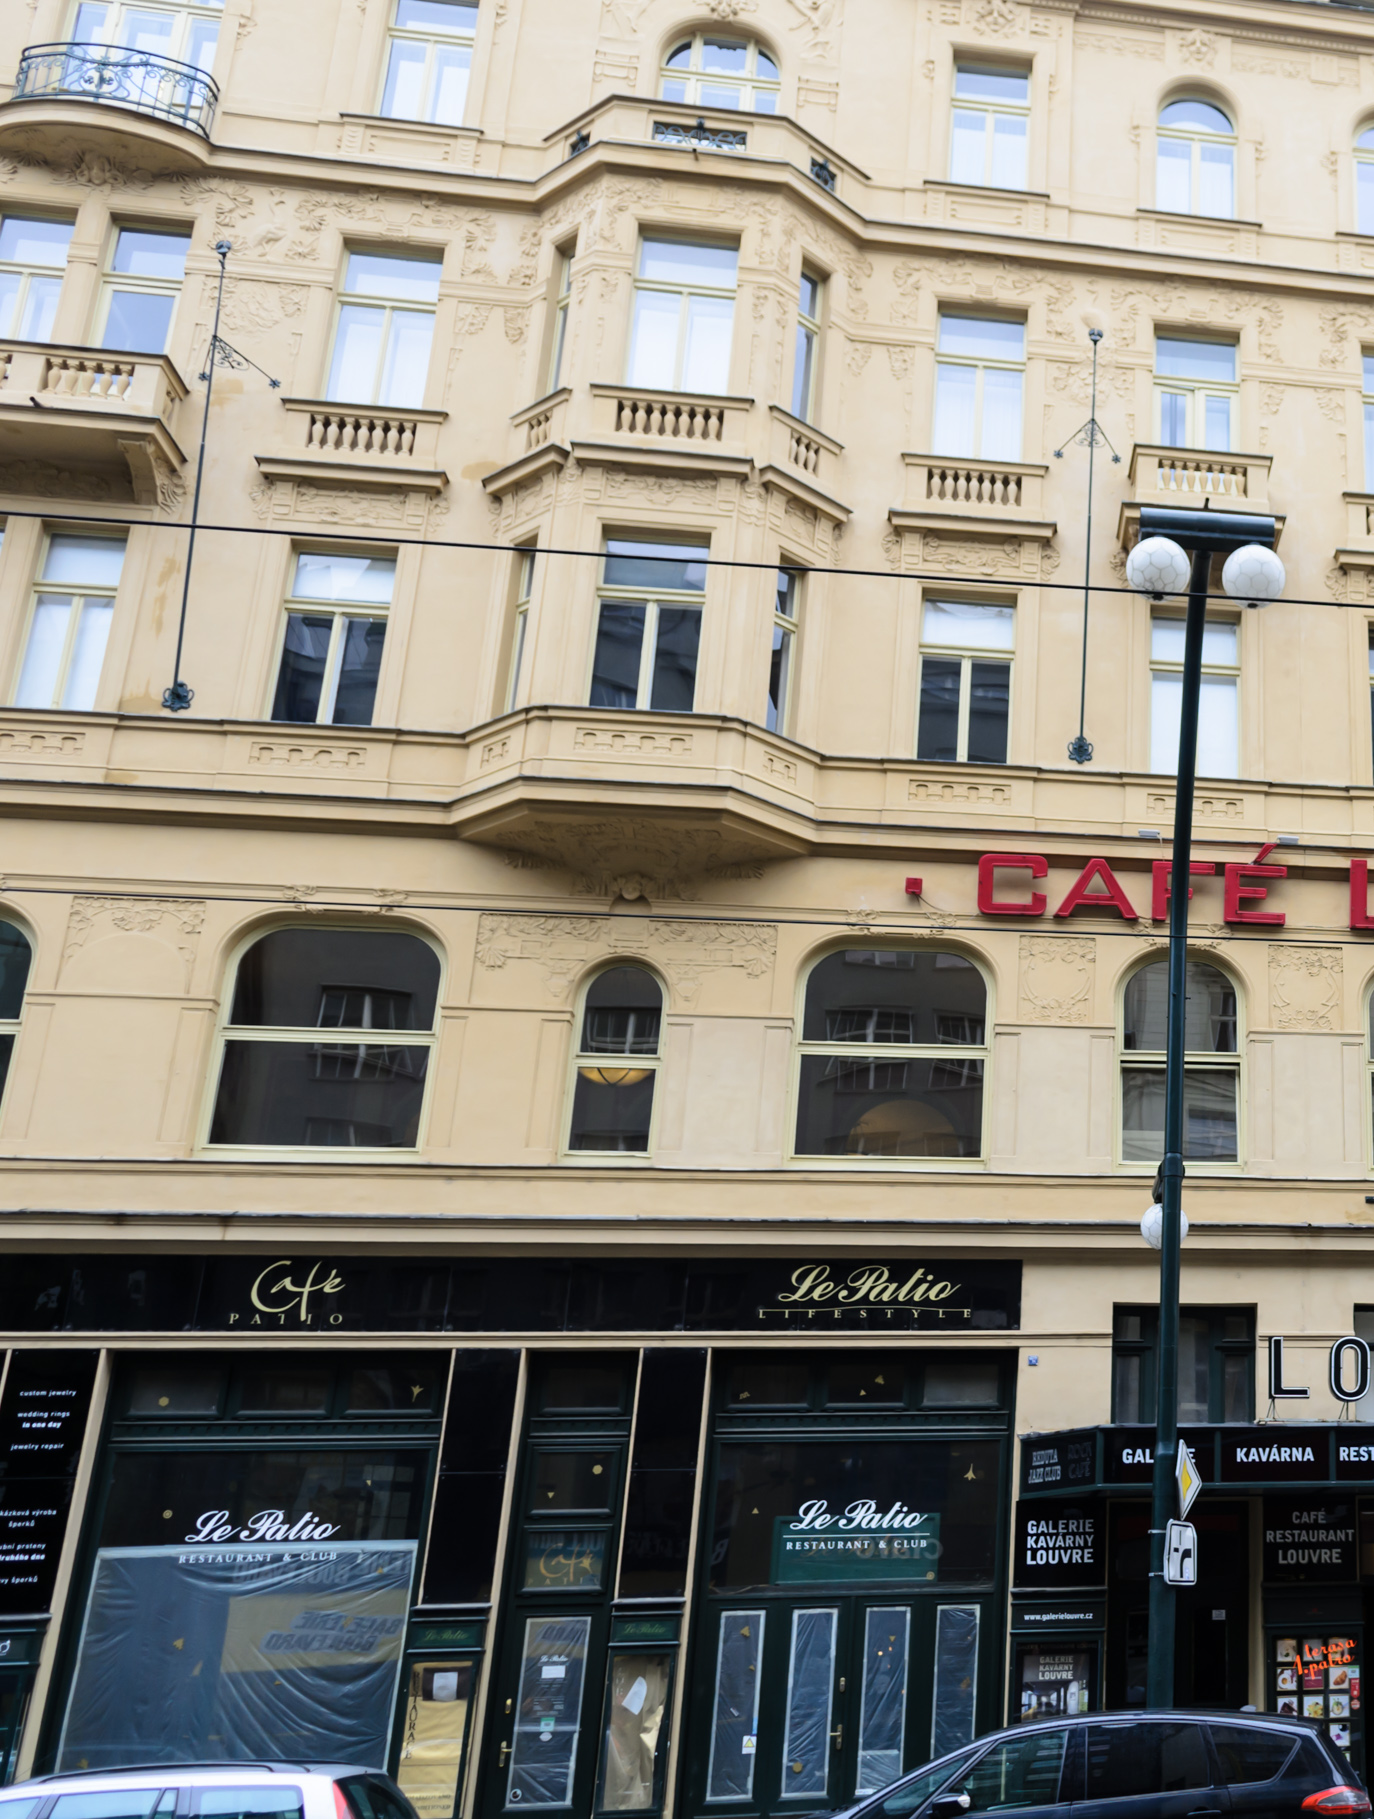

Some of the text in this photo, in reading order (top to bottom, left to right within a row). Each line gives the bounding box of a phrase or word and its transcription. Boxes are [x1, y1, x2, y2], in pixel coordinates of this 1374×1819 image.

[977, 841, 1288, 924] CAFÉ
[250, 1260, 346, 1321] Café
[778, 1265, 961, 1303] Le Patio
[228, 1313, 343, 1325] PATIO
[759, 1309, 971, 1318] LIFESTYLE
[48, 1389, 77, 1397] jewelry
[10, 1443, 39, 1451] jewelry
[1236, 1444, 1315, 1462] KAVÁRNA
[1032, 1449, 1059, 1466] REDUTA
[1028, 1465, 1062, 1484] JAZZ CLUB
[789, 1499, 928, 1530] Le Patio
[1292, 1508, 1327, 1524] CAFÉ
[185, 1509, 341, 1542] Le Patio
[1027, 1519, 1095, 1534] GALERIE
[1027, 1533, 1094, 1549] KAVÁRNY
[1266, 1529, 1355, 1543] RESTAURANT
[786, 1540, 928, 1550] RESTAURANT & CLUB
[178, 1552, 338, 1564] RESTAURANT & CLUB
[1026, 1549, 1094, 1565] LOUVRE
[1278, 1549, 1342, 1564] LOUVRE
[1024, 1613, 1093, 1621] www.galerielouvre.cz
[1305, 1639, 1357, 1658] terasa
[1039, 1663, 1073, 1671] KAVÁRNY
[1038, 1671, 1074, 1680] LOUVRE
